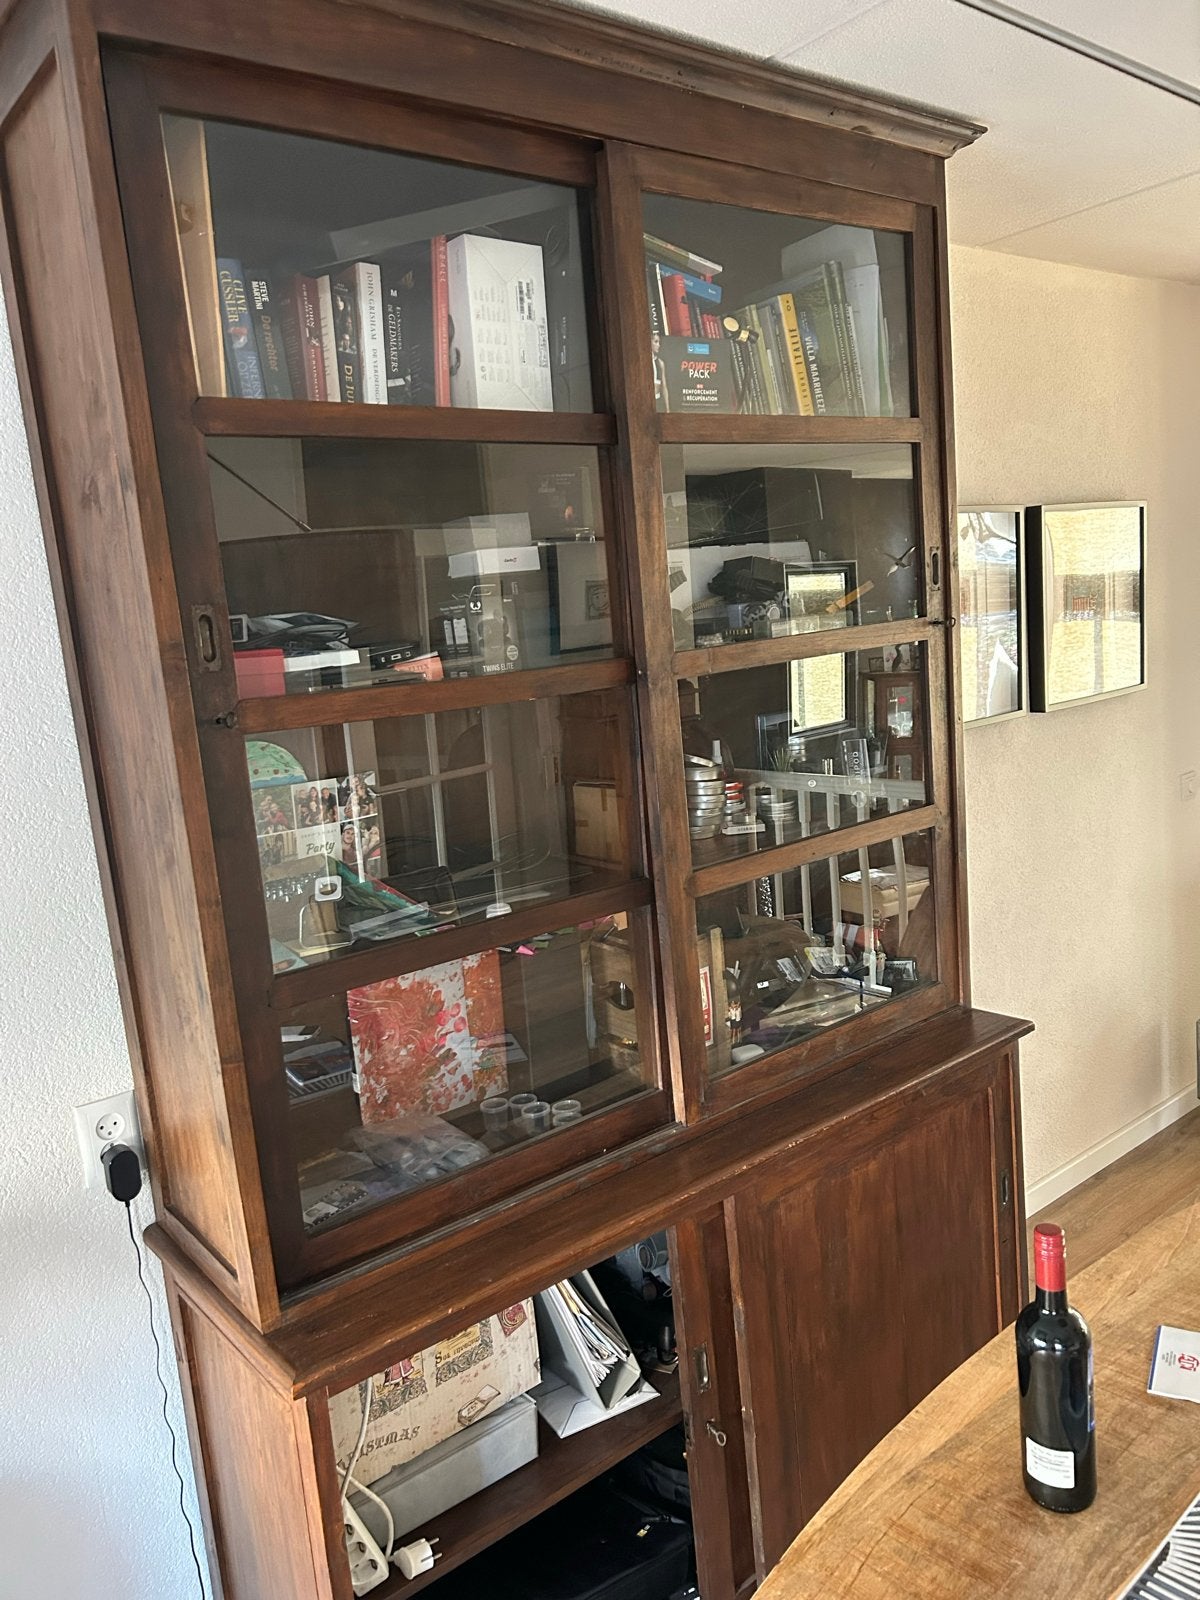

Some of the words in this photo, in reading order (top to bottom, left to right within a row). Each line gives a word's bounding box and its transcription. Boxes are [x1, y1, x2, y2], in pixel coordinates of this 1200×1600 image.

[220, 270, 239, 322] CUSSLER
[232, 279, 248, 315] CLIVE
[251, 280, 263, 310] MARTINI
[258, 281, 269, 302] STEVE
[366, 271, 374, 297] JOHN
[368, 298, 377, 341] GRISHAM
[388, 313, 399, 373] GELDMAKERS
[804, 335, 815, 362] VILLA
[343, 364, 354, 383] DE
[681, 360, 717, 373] POWER
[689, 369, 710, 379] PACK
[809, 363, 826, 414] MAARHEEZE
[483, 663, 500, 673] TWINS
[500, 662, 514, 671] ELITE
[306, 840, 336, 855] Party
